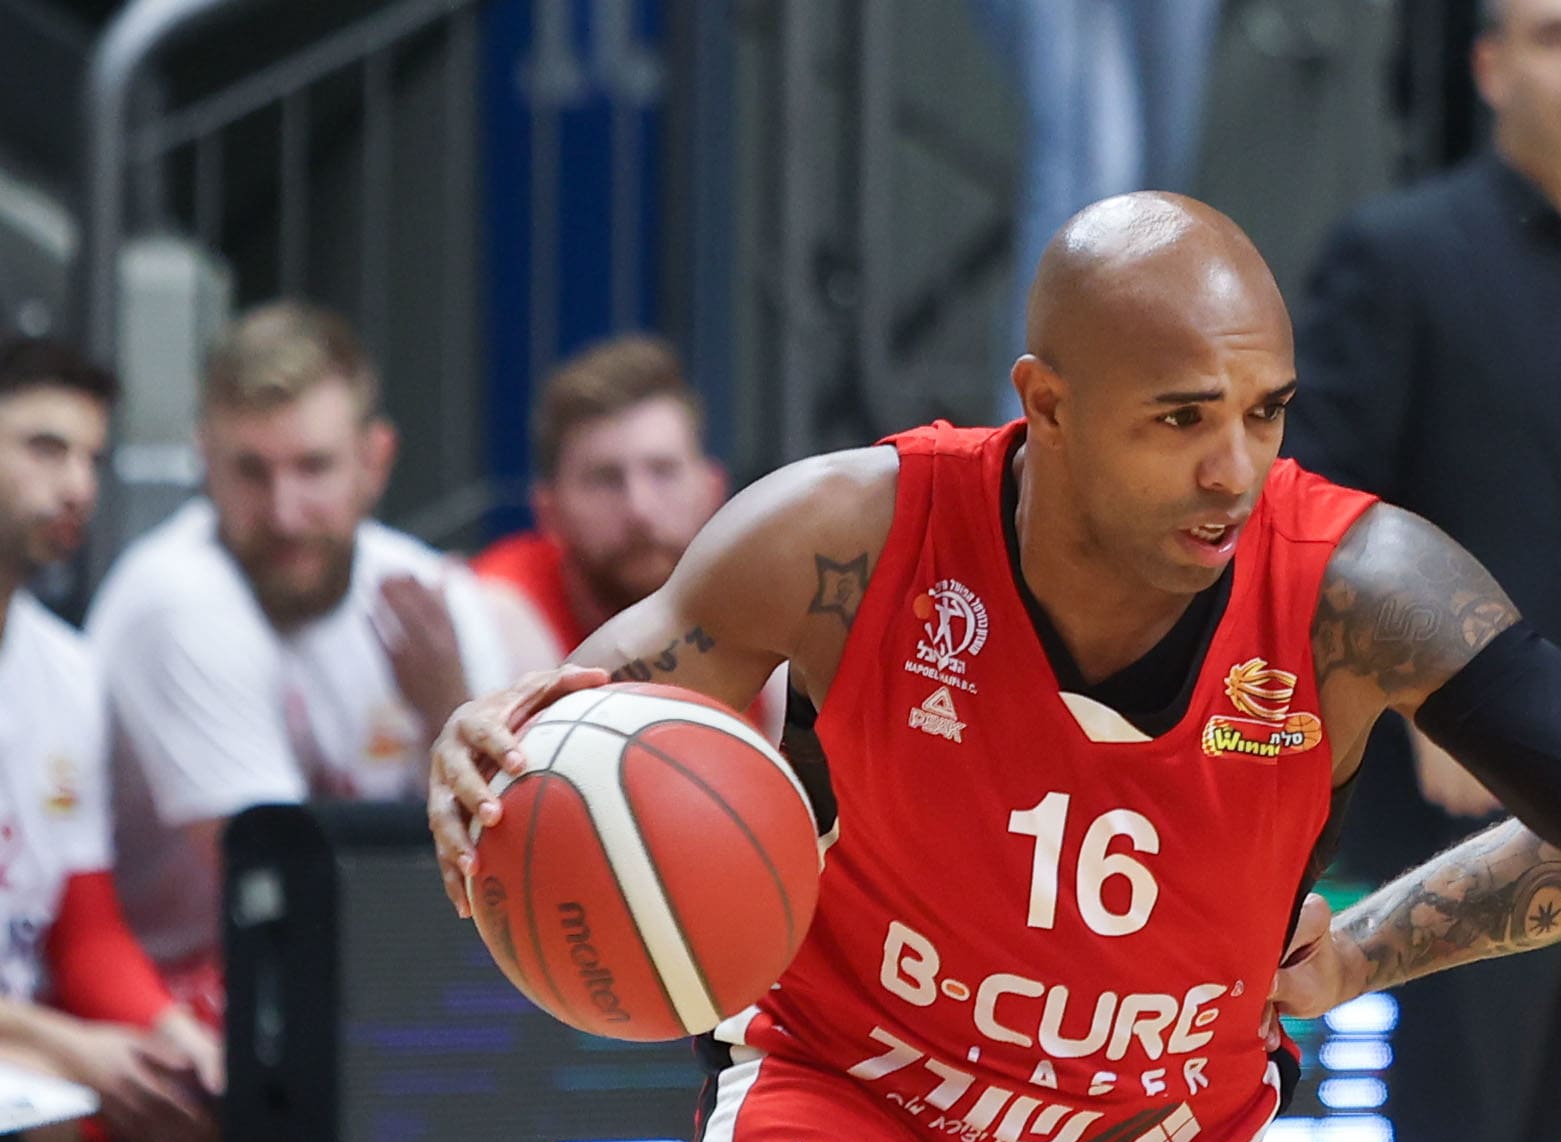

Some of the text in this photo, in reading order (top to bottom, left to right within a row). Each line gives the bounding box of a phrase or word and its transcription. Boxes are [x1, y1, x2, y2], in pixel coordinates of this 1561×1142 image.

[908, 707, 967, 744] PEAK
[1007, 791, 1160, 936] 16
[558, 902, 631, 1023] molten
